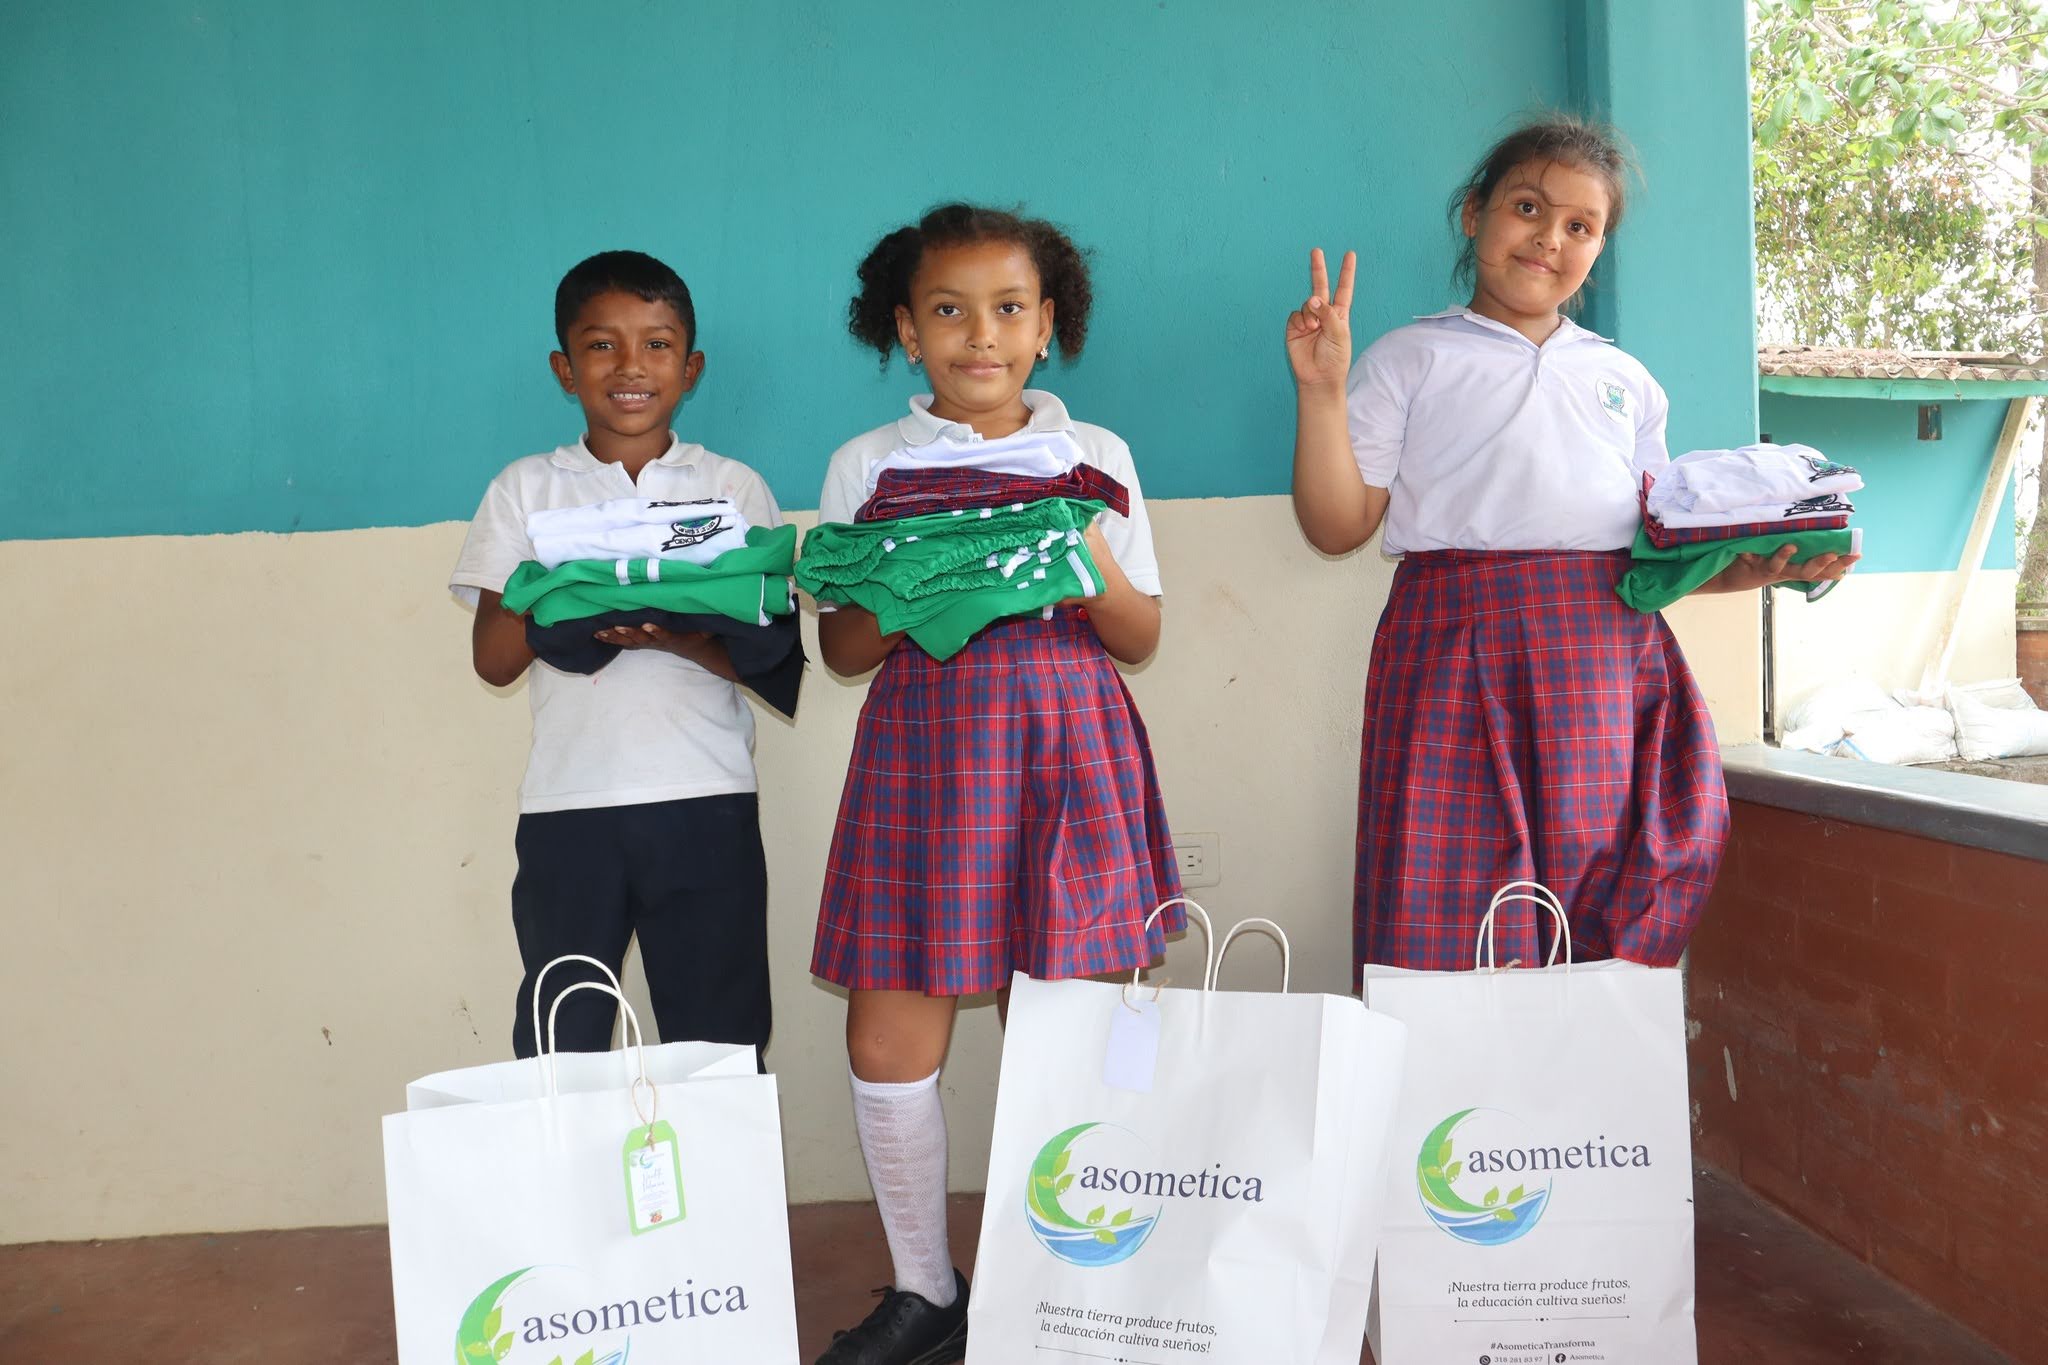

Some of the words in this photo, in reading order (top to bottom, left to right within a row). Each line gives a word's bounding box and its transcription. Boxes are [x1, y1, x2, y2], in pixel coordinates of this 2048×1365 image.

[1468, 1135, 1652, 1173] asometica
[1080, 1163, 1264, 1203] asometica
[1448, 1281, 1500, 1294] ¡Nuestra
[1503, 1280, 1536, 1292] tierra
[1540, 1279, 1588, 1295] produce
[1592, 1278, 1630, 1291] frutos,
[1458, 1296, 1468, 1308] la
[1472, 1295, 1532, 1308] educación
[1536, 1294, 1578, 1306] cultiva
[1581, 1294, 1626, 1306] sueños!
[523, 1279, 749, 1344] asometica
[1035, 1301, 1084, 1319] ¡Nuestra
[1087, 1309, 1122, 1325] tierra
[1125, 1315, 1173, 1331] produce
[1175, 1319, 1217, 1336] frutos,
[1040, 1319, 1051, 1332] la
[1053, 1322, 1115, 1342] educación
[1118, 1332, 1159, 1348] cultiva
[1162, 1338, 1211, 1354] sueños!
[1490, 1340, 1595, 1351] #AsometicaTransforma
[1569, 1353, 1605, 1361] Asometica
